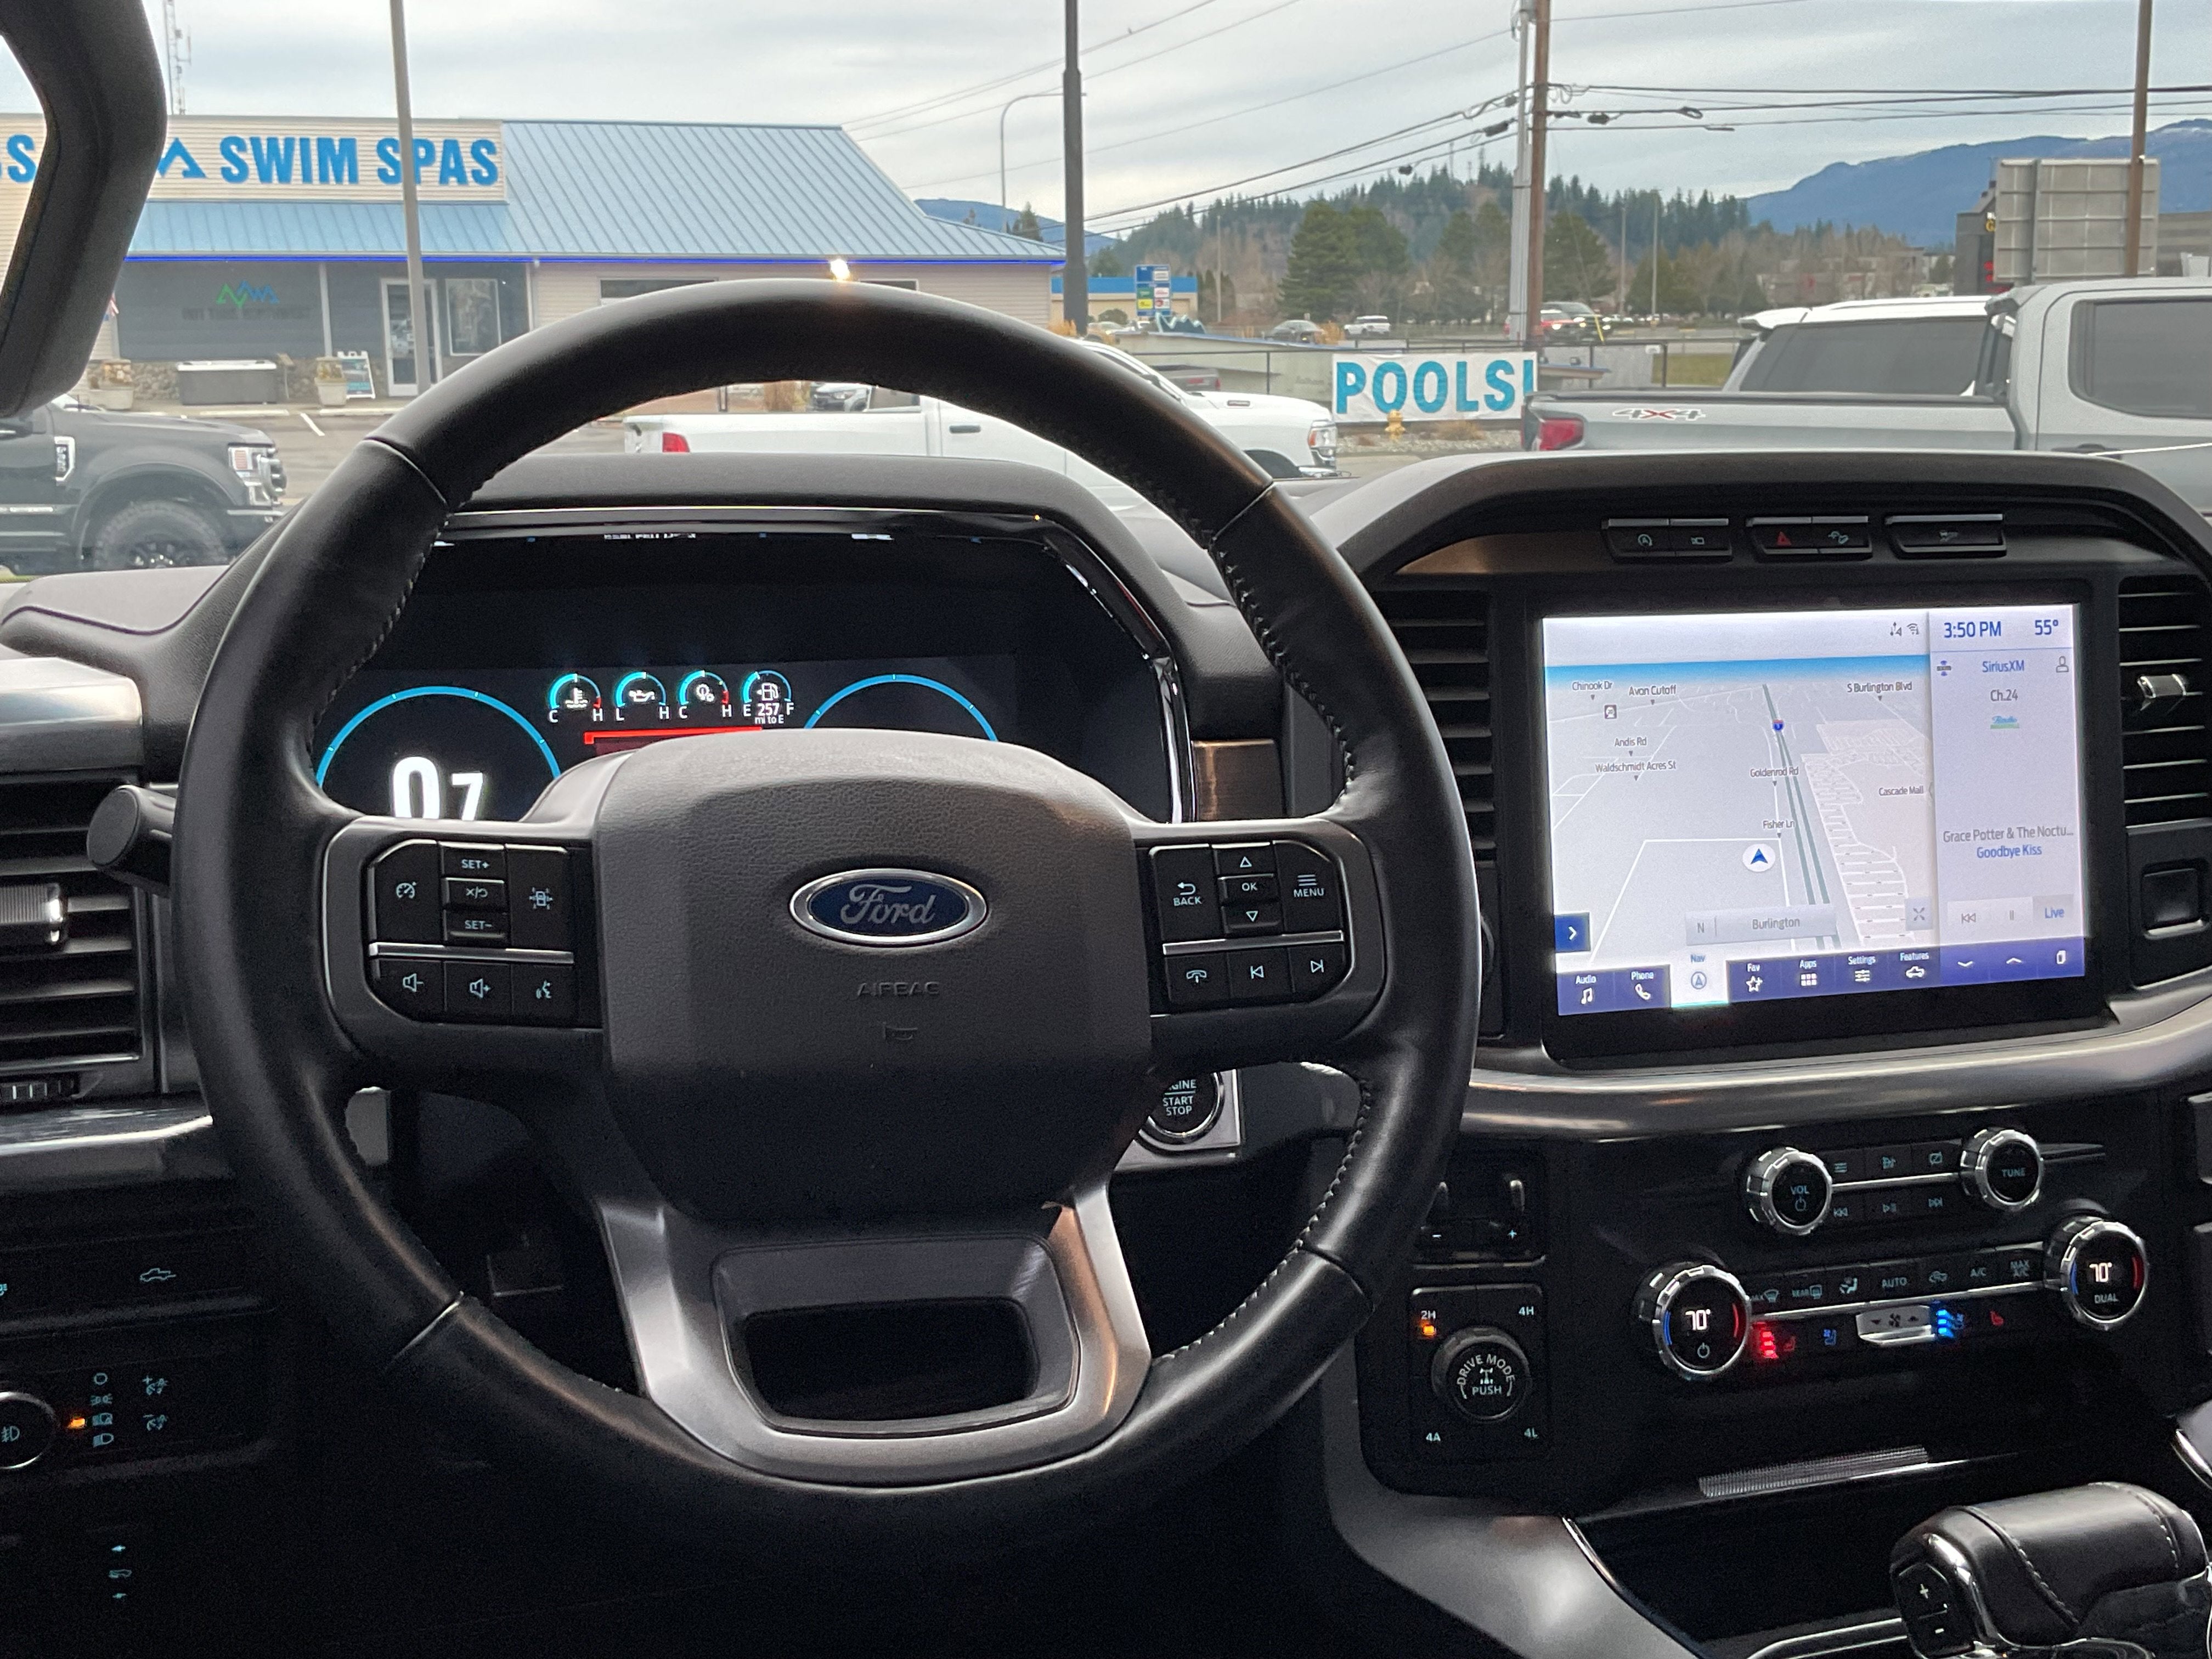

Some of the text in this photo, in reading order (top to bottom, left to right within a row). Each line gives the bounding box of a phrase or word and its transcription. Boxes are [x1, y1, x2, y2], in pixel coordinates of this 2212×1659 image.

[219, 136, 499, 185] SWIM SPAS
[1944, 621, 2002, 638] 3:50 PM
[1982, 659, 2024, 673] SiriusXM
[1604, 681, 1612, 690] Dr
[1847, 681, 1912, 693] S Burlington Blvd
[1990, 689, 2018, 702] Ch.24
[616, 707, 625, 721] L
[659, 707, 669, 719] H
[679, 706, 688, 719] C
[722, 706, 732, 718] H
[743, 704, 752, 716] E
[758, 703, 780, 716] 257
[786, 702, 794, 715] F
[549, 710, 558, 723] C
[592, 708, 603, 721] H
[755, 714, 785, 724] mi to E
[1615, 737, 1647, 747] Andis Rd
[1595, 760, 1676, 772] Waldschmidt Acres St
[1750, 766, 1799, 777] Goldenrod Rd
[1879, 786, 1924, 797] Cascade Mall
[1763, 820, 1795, 829] Fisher Ln
[1943, 831, 1971, 843] Grace
[1973, 829, 2005, 840] Potter
[2006, 827, 2015, 839] &
[2017, 826, 2035, 838] The
[1977, 844, 2042, 859] Goodbye Kiss
[1242, 882, 1258, 891] OK
[1293, 888, 1325, 898] MENU
[840, 884, 936, 924] Ford
[1173, 896, 1203, 906] BACK
[2045, 907, 2064, 918] Live
[1697, 923, 1705, 933] N
[1752, 917, 1800, 930] Burlington
[1690, 954, 1706, 963] Nav
[1848, 955, 1876, 966] Settings
[1900, 952, 1929, 962] Features
[1747, 963, 1760, 972] Fav
[1799, 960, 1816, 969] Apps
[1576, 975, 1596, 984] Audio
[1631, 970, 1654, 980] Phone
[1163, 1096, 1193, 1107] START
[1166, 1105, 1192, 1116] STOP
[2001, 1167, 2025, 1178] TUNE
[1790, 1185, 1810, 1195] VOL
[1881, 1277, 1908, 1288] AUTO
[2094, 1292, 2118, 1304] DUAL
[1421, 1310, 1436, 1319] 2H
[1518, 1306, 1534, 1316] 4H
[1457, 1353, 1516, 1385] DRIVE MODE
[1472, 1386, 1502, 1396] PUSH
[1426, 1432, 1441, 1442] 4A
[1523, 1427, 1538, 1438] 4L
